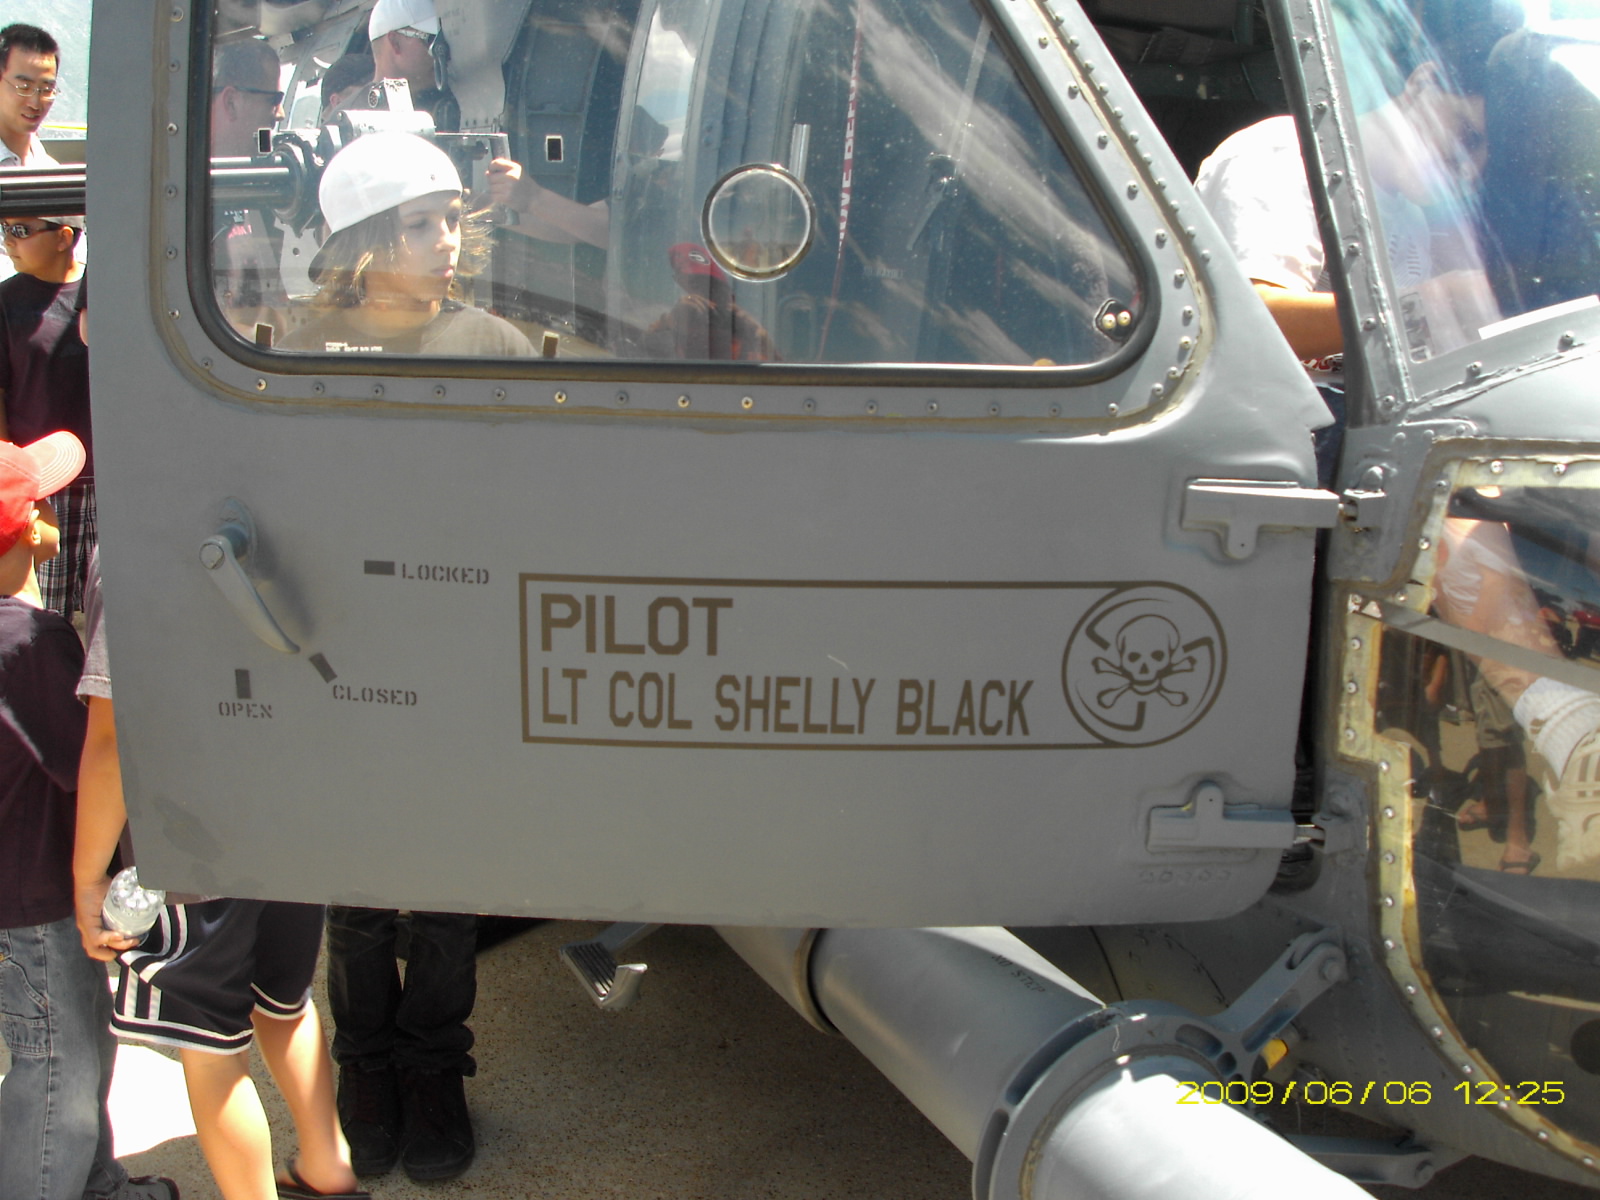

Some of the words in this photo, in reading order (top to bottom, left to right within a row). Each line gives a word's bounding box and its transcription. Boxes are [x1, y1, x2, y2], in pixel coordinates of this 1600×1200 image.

[402, 563, 490, 585] LOCKED
[540, 593, 734, 657] PILOT
[332, 684, 417, 706] CLOSED
[542, 667, 588, 725] LT
[609, 671, 693, 730] COL
[714, 674, 876, 735] SHELLY
[896, 679, 1034, 736] BLACK
[218, 701, 273, 719] OPEN
